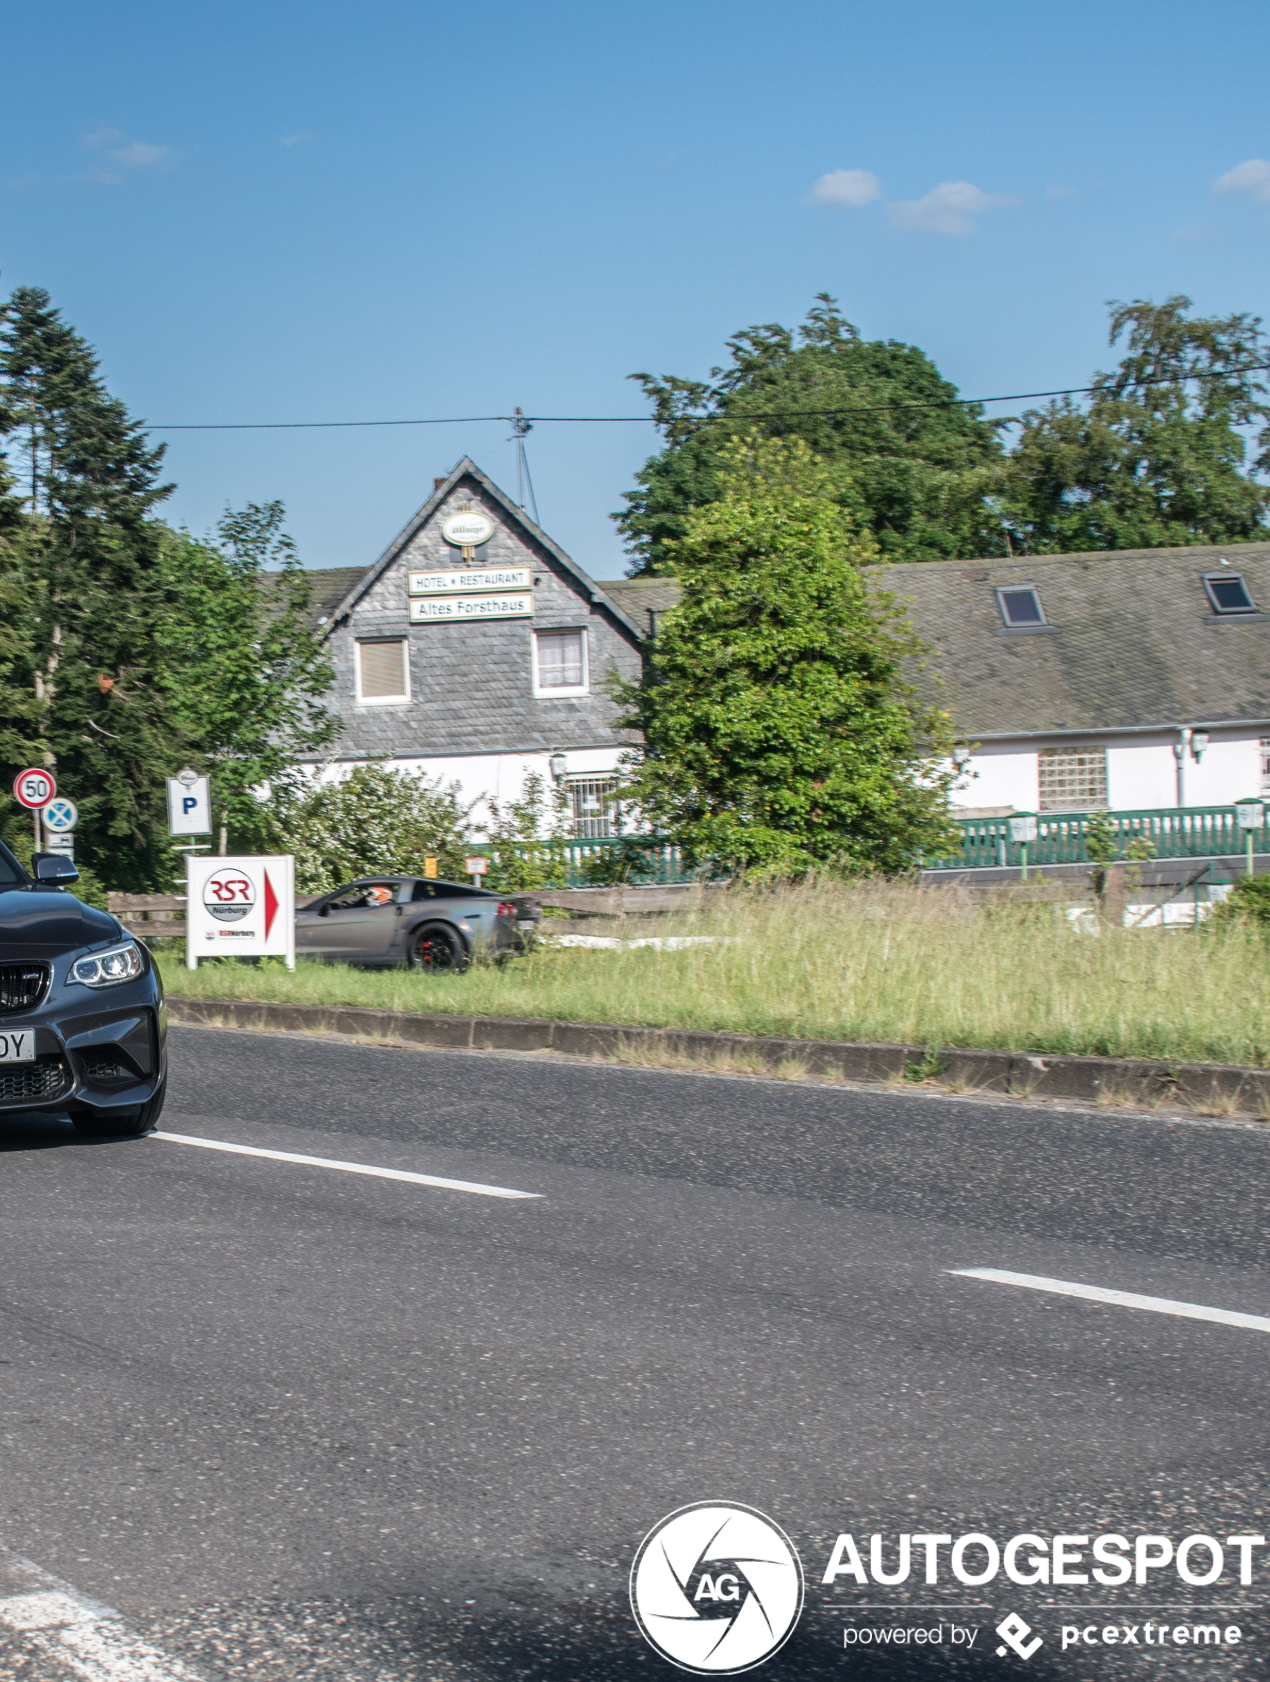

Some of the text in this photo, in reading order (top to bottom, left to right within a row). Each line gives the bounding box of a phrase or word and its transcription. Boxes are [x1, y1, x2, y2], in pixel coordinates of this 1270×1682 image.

[416, 573, 524, 589] HOTEL RESTAURANT
[419, 600, 525, 615] Altes Forsthaus
[25, 780, 47, 798] 50
[182, 797, 198, 815] P
[211, 880, 250, 901] RSR
[213, 907, 247, 915] Nürburg
